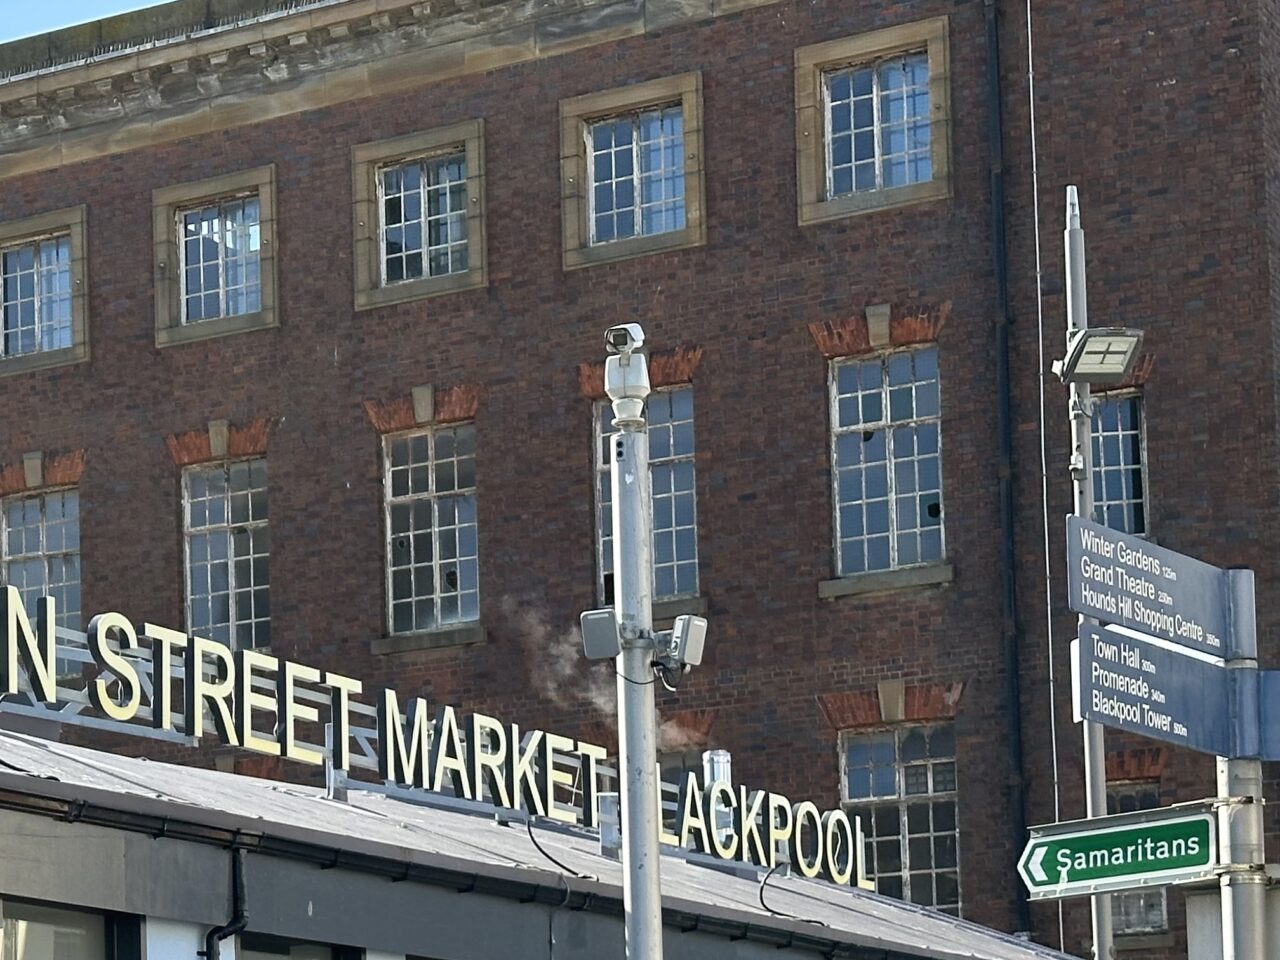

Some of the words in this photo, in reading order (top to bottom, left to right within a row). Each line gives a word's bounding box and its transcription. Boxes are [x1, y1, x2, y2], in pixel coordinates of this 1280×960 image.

[1080, 527, 1115, 559] Winter
[1117, 541, 1160, 576] Gardens
[1162, 566, 1177, 581] 125m
[1081, 555, 1114, 586] Grand
[1116, 567, 1155, 600] Theatre
[1081, 582, 1116, 614] Hounds
[1118, 594, 1132, 619] Hill
[1133, 600, 1174, 638] Shopping
[1175, 614, 1203, 642] Centre
[1091, 634, 1119, 663] Town
[1121, 642, 1140, 670] Hall
[1092, 661, 1149, 699] Promenade
[1092, 689, 1140, 724] Blackpool
[1142, 703, 1172, 732] Tower
[88, 611, 363, 773] STREET
[379, 688, 608, 828] MARKET
[656, 761, 876, 892] LACKPOOL
[1056, 836, 1200, 872] Samaritans
